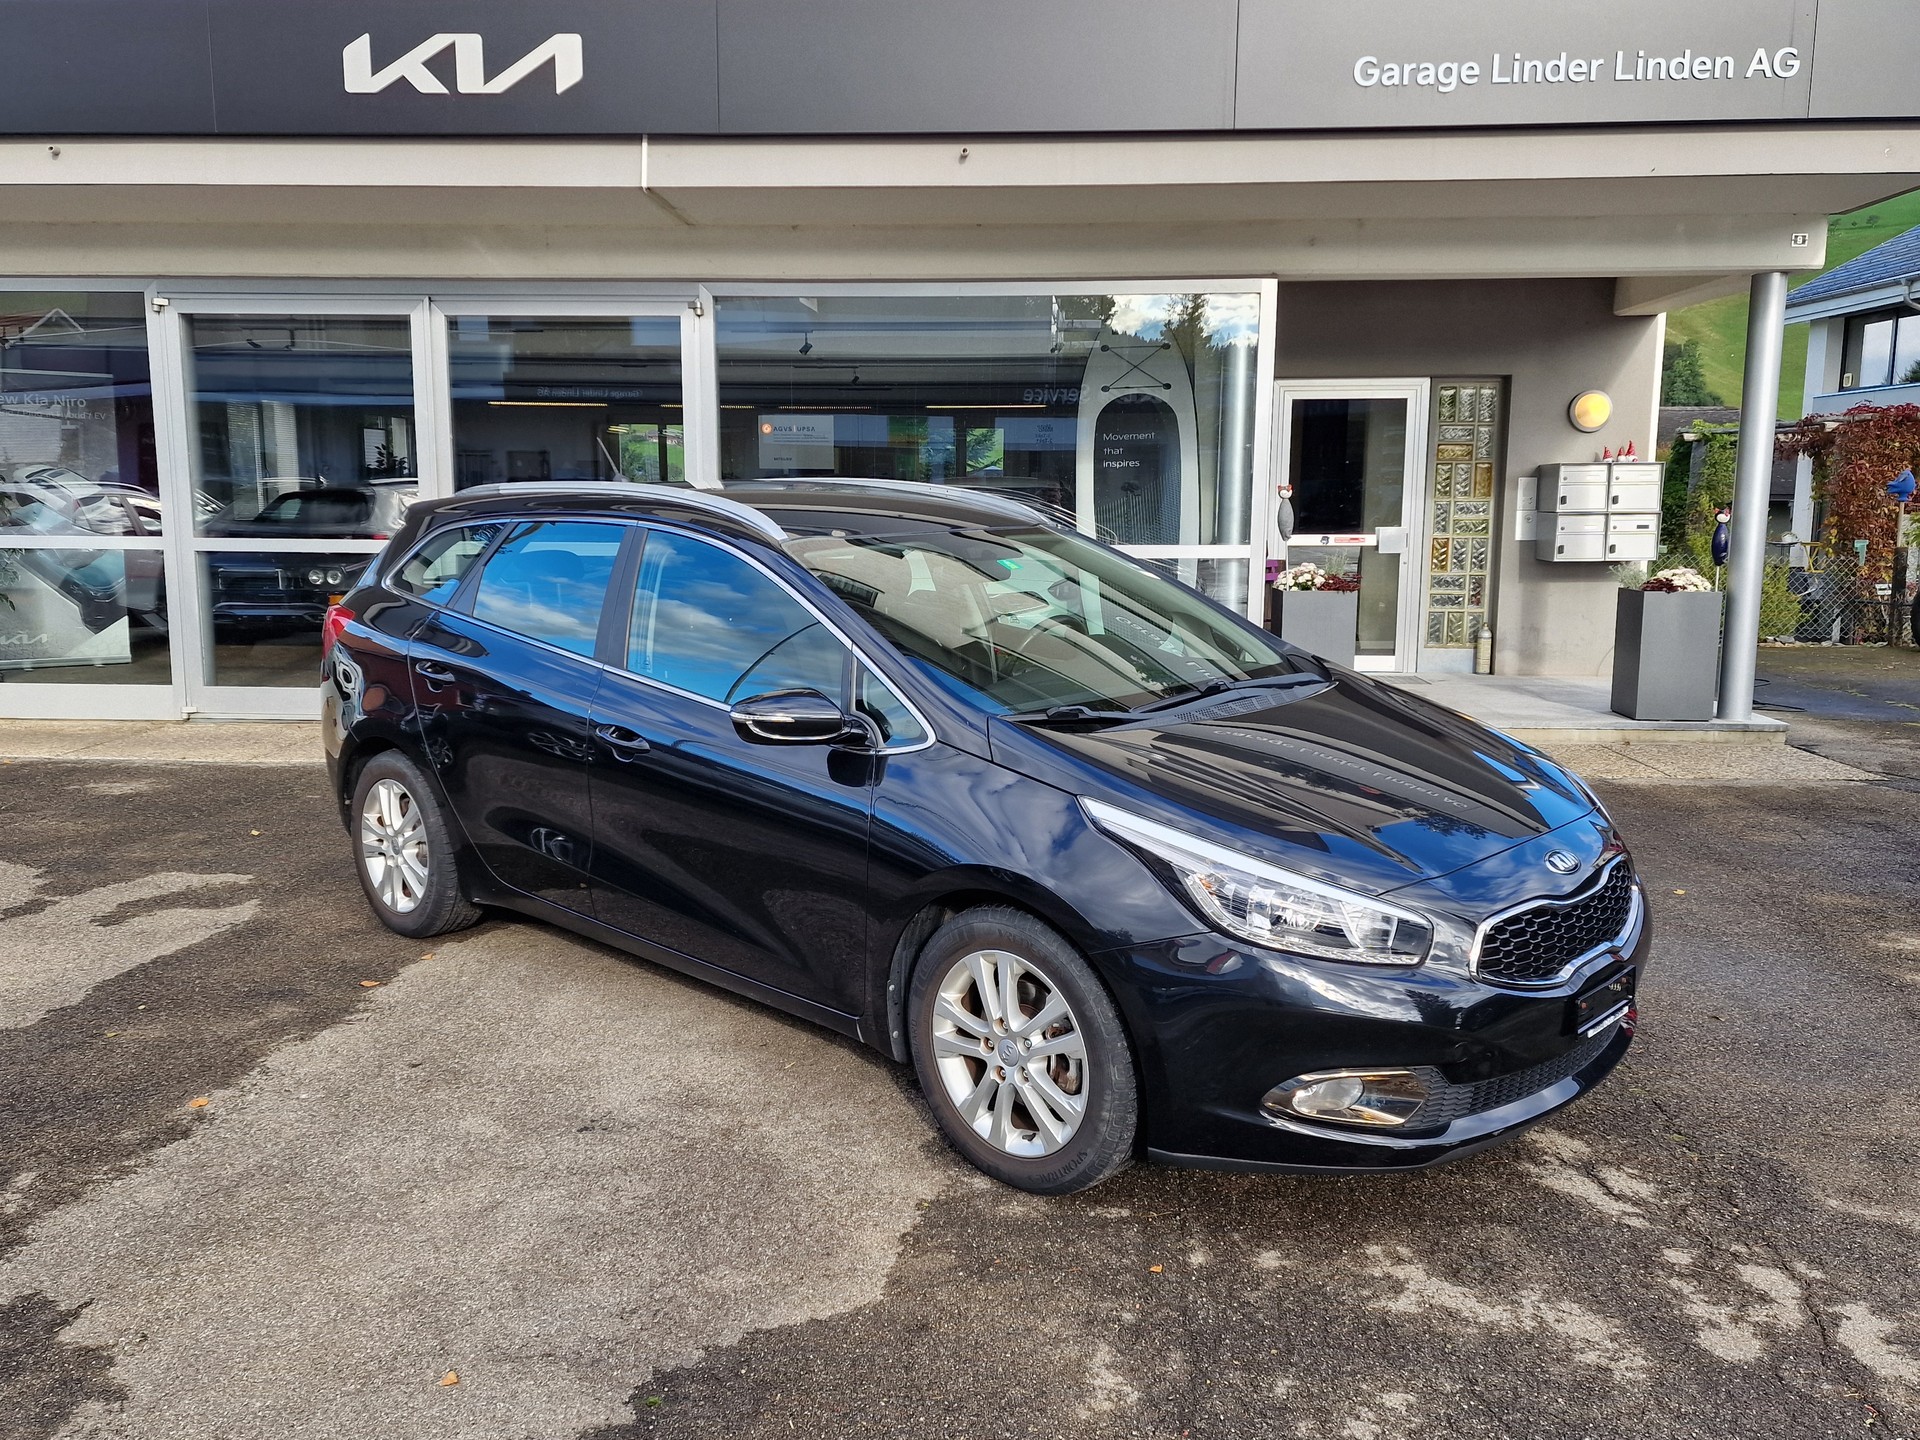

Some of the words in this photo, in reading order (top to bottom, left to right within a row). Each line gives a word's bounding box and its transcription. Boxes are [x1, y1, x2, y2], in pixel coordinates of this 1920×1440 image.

[342, 32, 584, 96] KIA
[1353, 55, 1481, 93] Garage
[1490, 51, 1605, 85] Linder
[1614, 49, 1735, 81] Linden
[1744, 46, 1801, 80] AG
[23, 393, 49, 406] Kia
[54, 394, 87, 408] Niro
[1103, 431, 1156, 441] Movement
[1103, 447, 1124, 455] that
[1103, 458, 1141, 470] inspires
